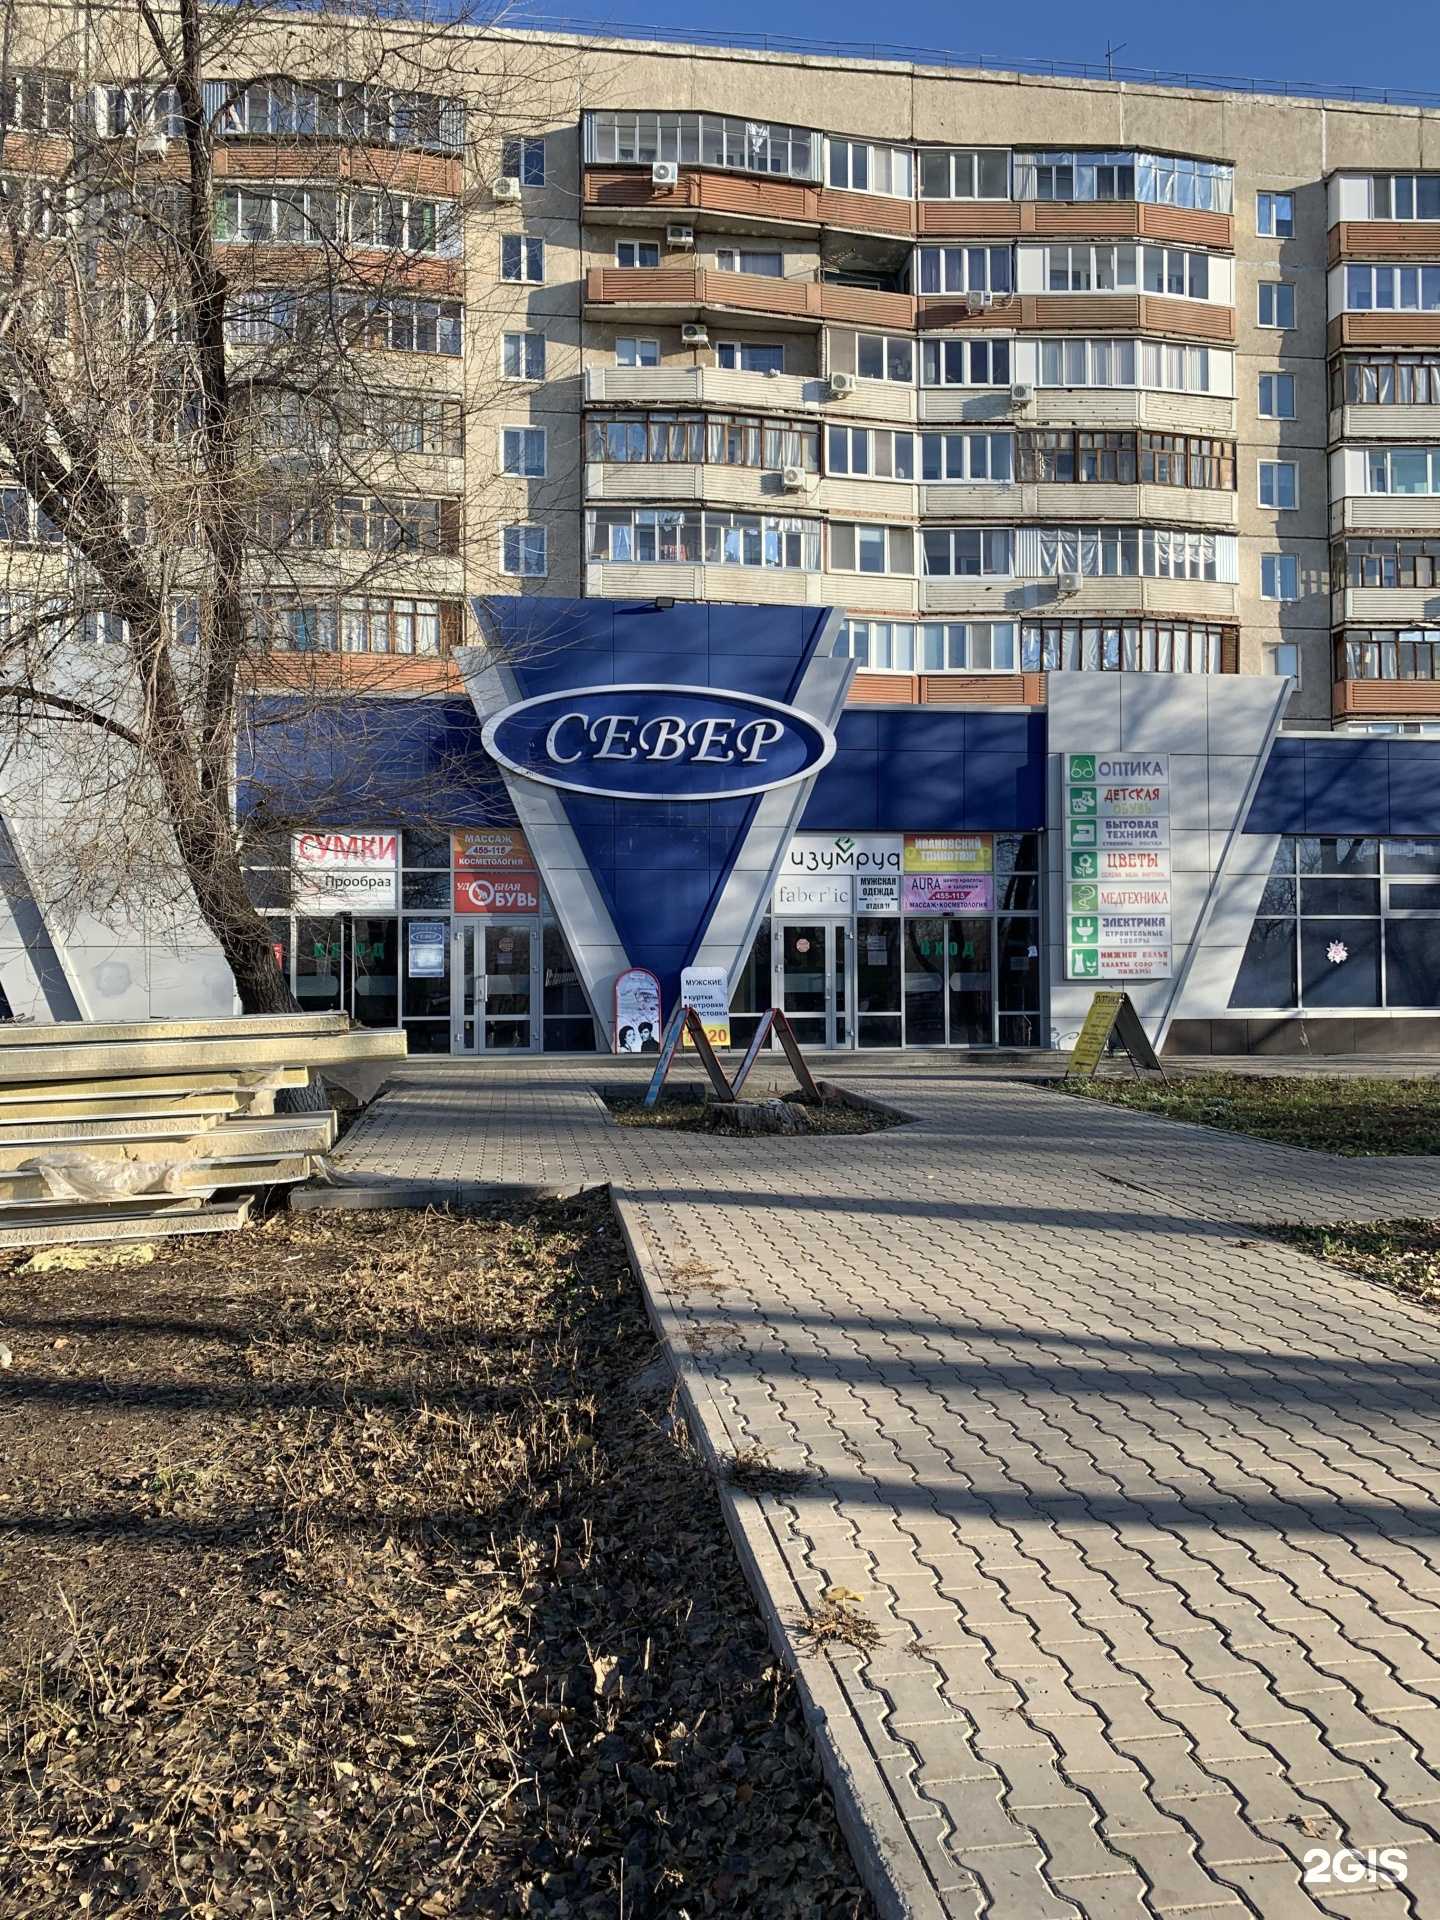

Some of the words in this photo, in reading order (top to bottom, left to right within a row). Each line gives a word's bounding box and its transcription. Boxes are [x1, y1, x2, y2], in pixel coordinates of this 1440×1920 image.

[545, 712, 785, 764] СЕВЕР
[1098, 761, 1164, 776] ОПТИКА
[1104, 788, 1160, 802] ДЕТСКАЯ
[1113, 803, 1152, 814] ОБУВЬ
[1105, 821, 1159, 829] БЫТОВАЯ
[464, 835, 512, 843] МАССАЖ
[1107, 830, 1158, 839] ТЕХНИКА
[299, 835, 397, 861] СУМКИ
[1107, 853, 1158, 869] ЦВЕТЫ
[325, 875, 392, 889] Прообраз
[860, 877, 897, 886] МУЖСКАЯ
[911, 878, 942, 890] AURA
[780, 886, 849, 903] faberic
[862, 888, 894, 896] ОДЕЖДА
[1101, 891, 1169, 906] МЕДТЕХНИКА
[1102, 918, 1166, 927] ЭЛЕКТРИКА
